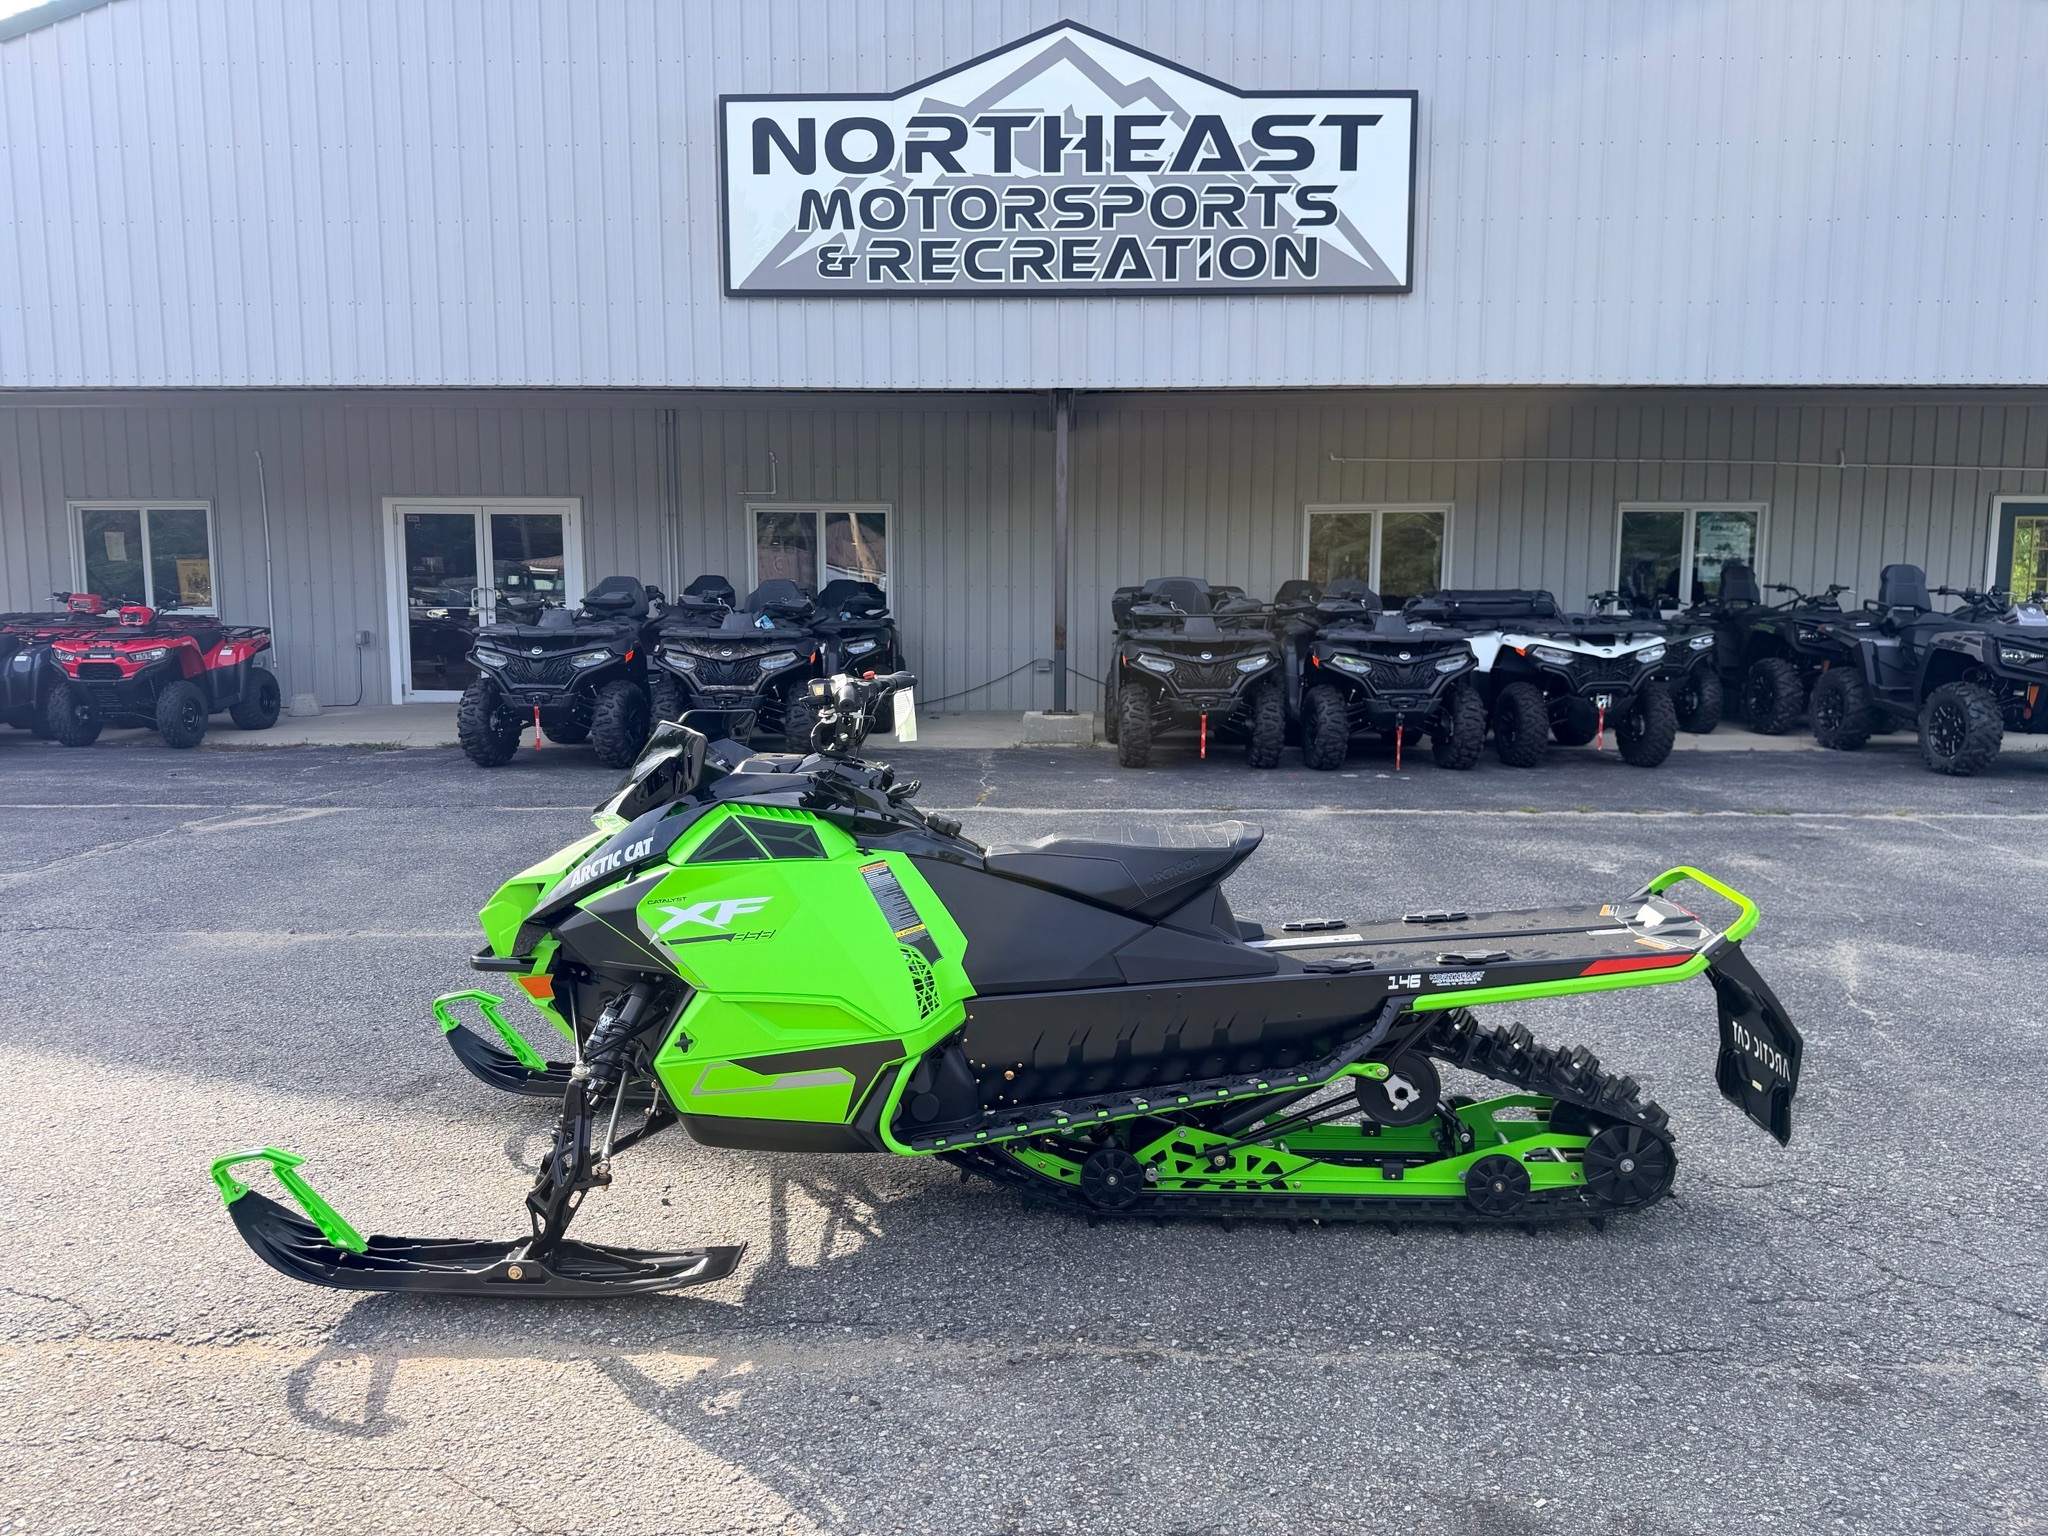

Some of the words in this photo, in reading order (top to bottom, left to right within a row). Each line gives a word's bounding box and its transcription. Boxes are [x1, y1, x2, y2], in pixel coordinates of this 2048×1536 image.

[751, 113, 1383, 176] NORTHEAST
[797, 184, 1338, 230] MOTORSPORTS
[817, 244, 857, 278] &
[868, 237, 1317, 281] RECREATION
[570, 849, 622, 888] ARCTIC
[624, 837, 653, 862] CAT
[647, 897, 687, 905] CATALYST
[649, 896, 774, 945] XF
[1387, 974, 1422, 990] 146
